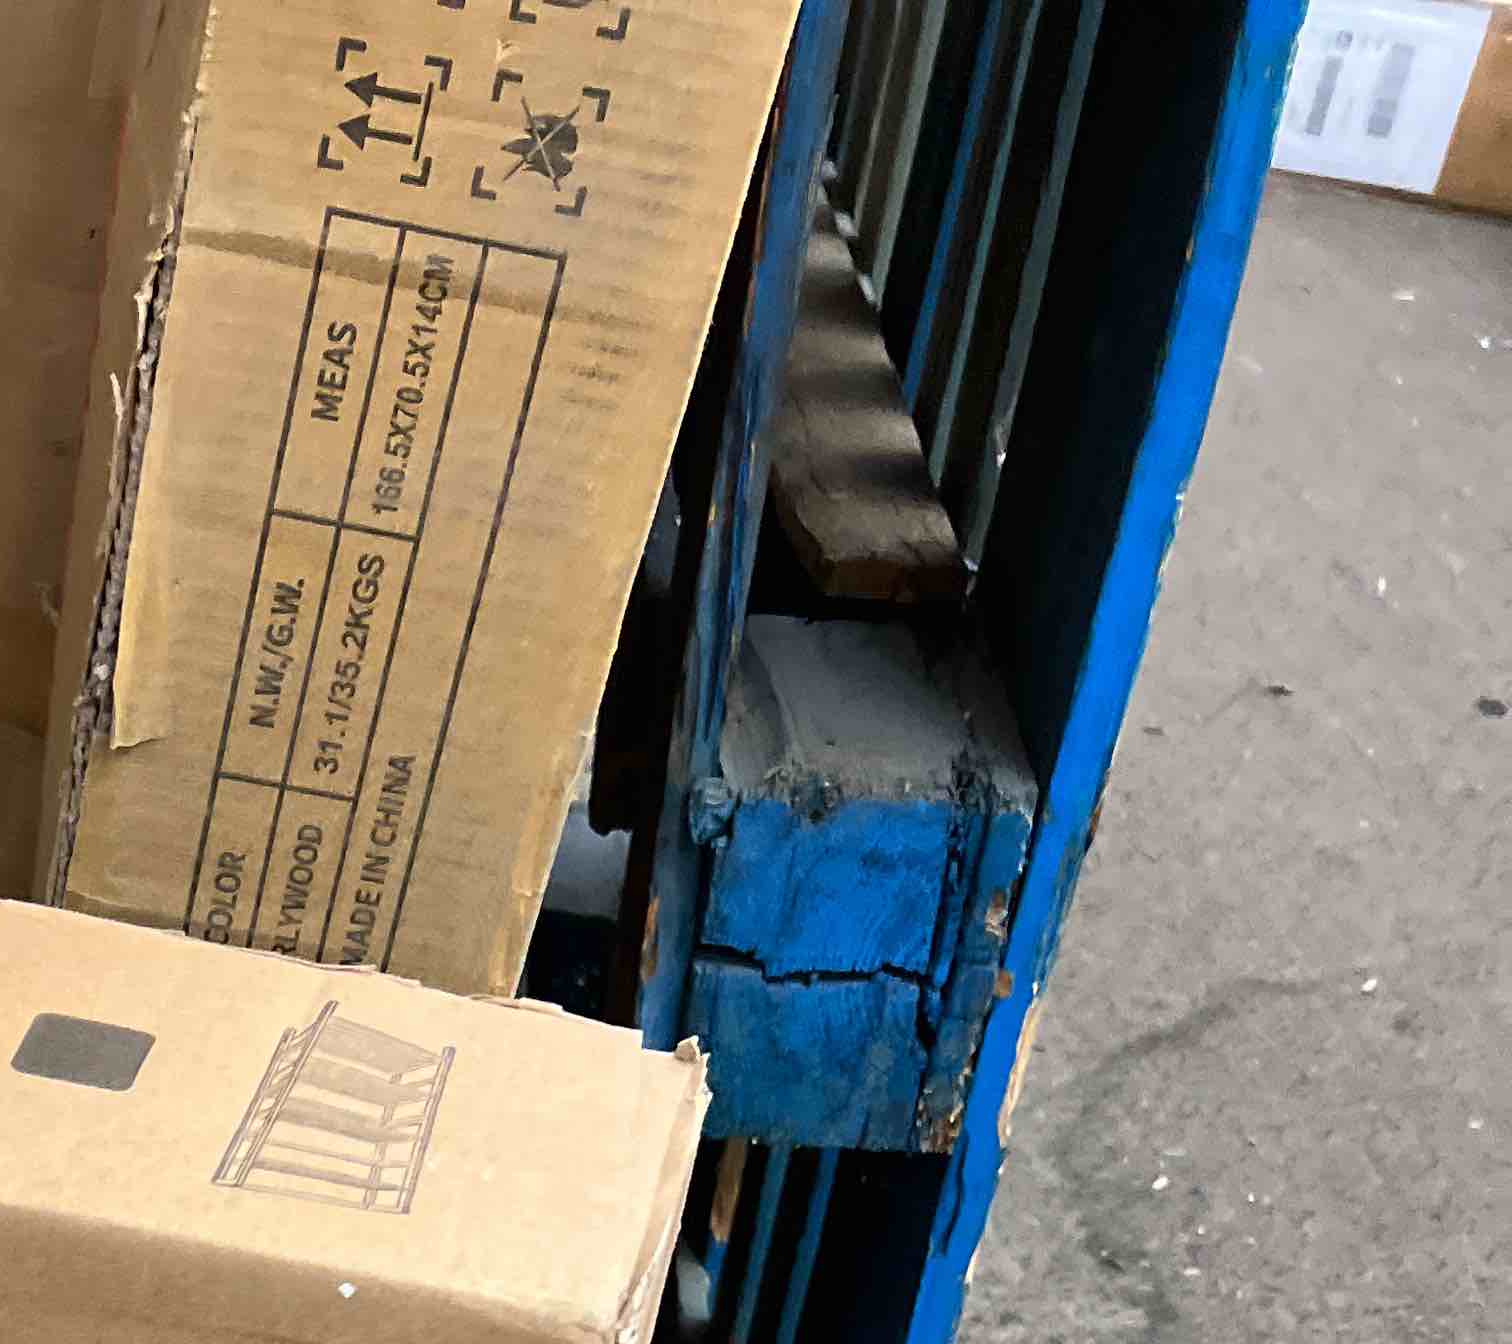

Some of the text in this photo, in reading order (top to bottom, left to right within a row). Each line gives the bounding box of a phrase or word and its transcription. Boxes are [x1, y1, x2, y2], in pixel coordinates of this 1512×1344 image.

[311, 322, 359, 423] MEAS
[371, 254, 459, 517] 166.5X70.5X14CM
[249, 577, 308, 731] N.W./G.W.
[310, 553, 386, 775] 31.1/35.2KGS
[369, 754, 416, 847] CHINA
[360, 852, 389, 884] IN
